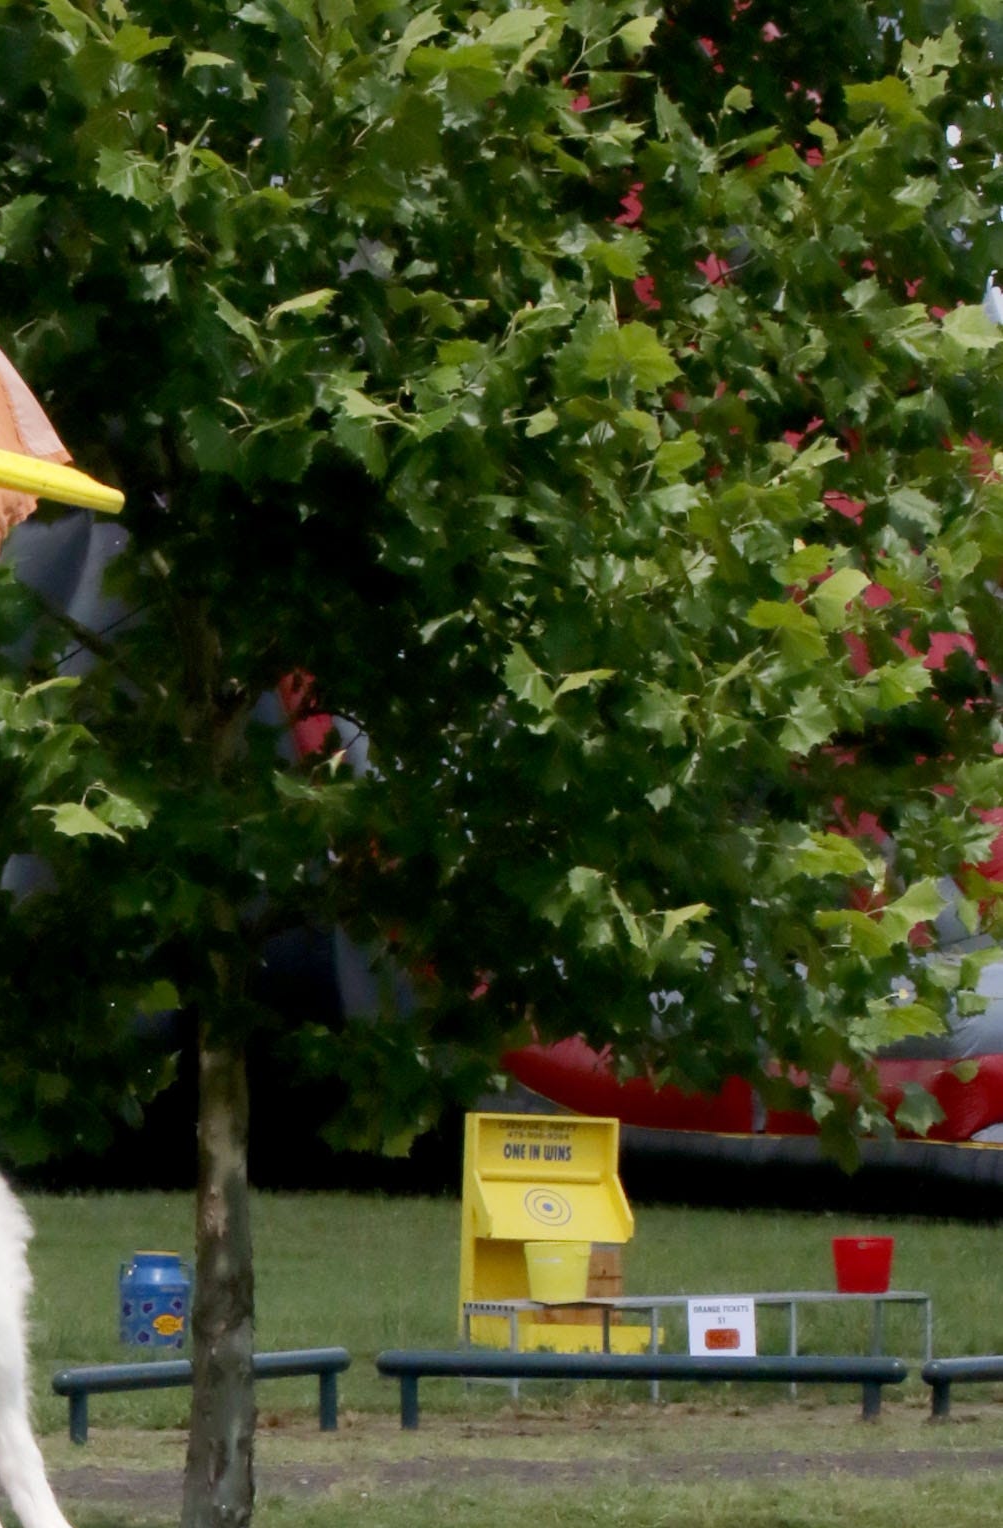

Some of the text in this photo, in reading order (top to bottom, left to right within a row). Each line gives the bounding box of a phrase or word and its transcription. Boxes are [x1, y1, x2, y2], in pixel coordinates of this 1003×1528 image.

[503, 1143, 572, 1161] ONE IN WINS
